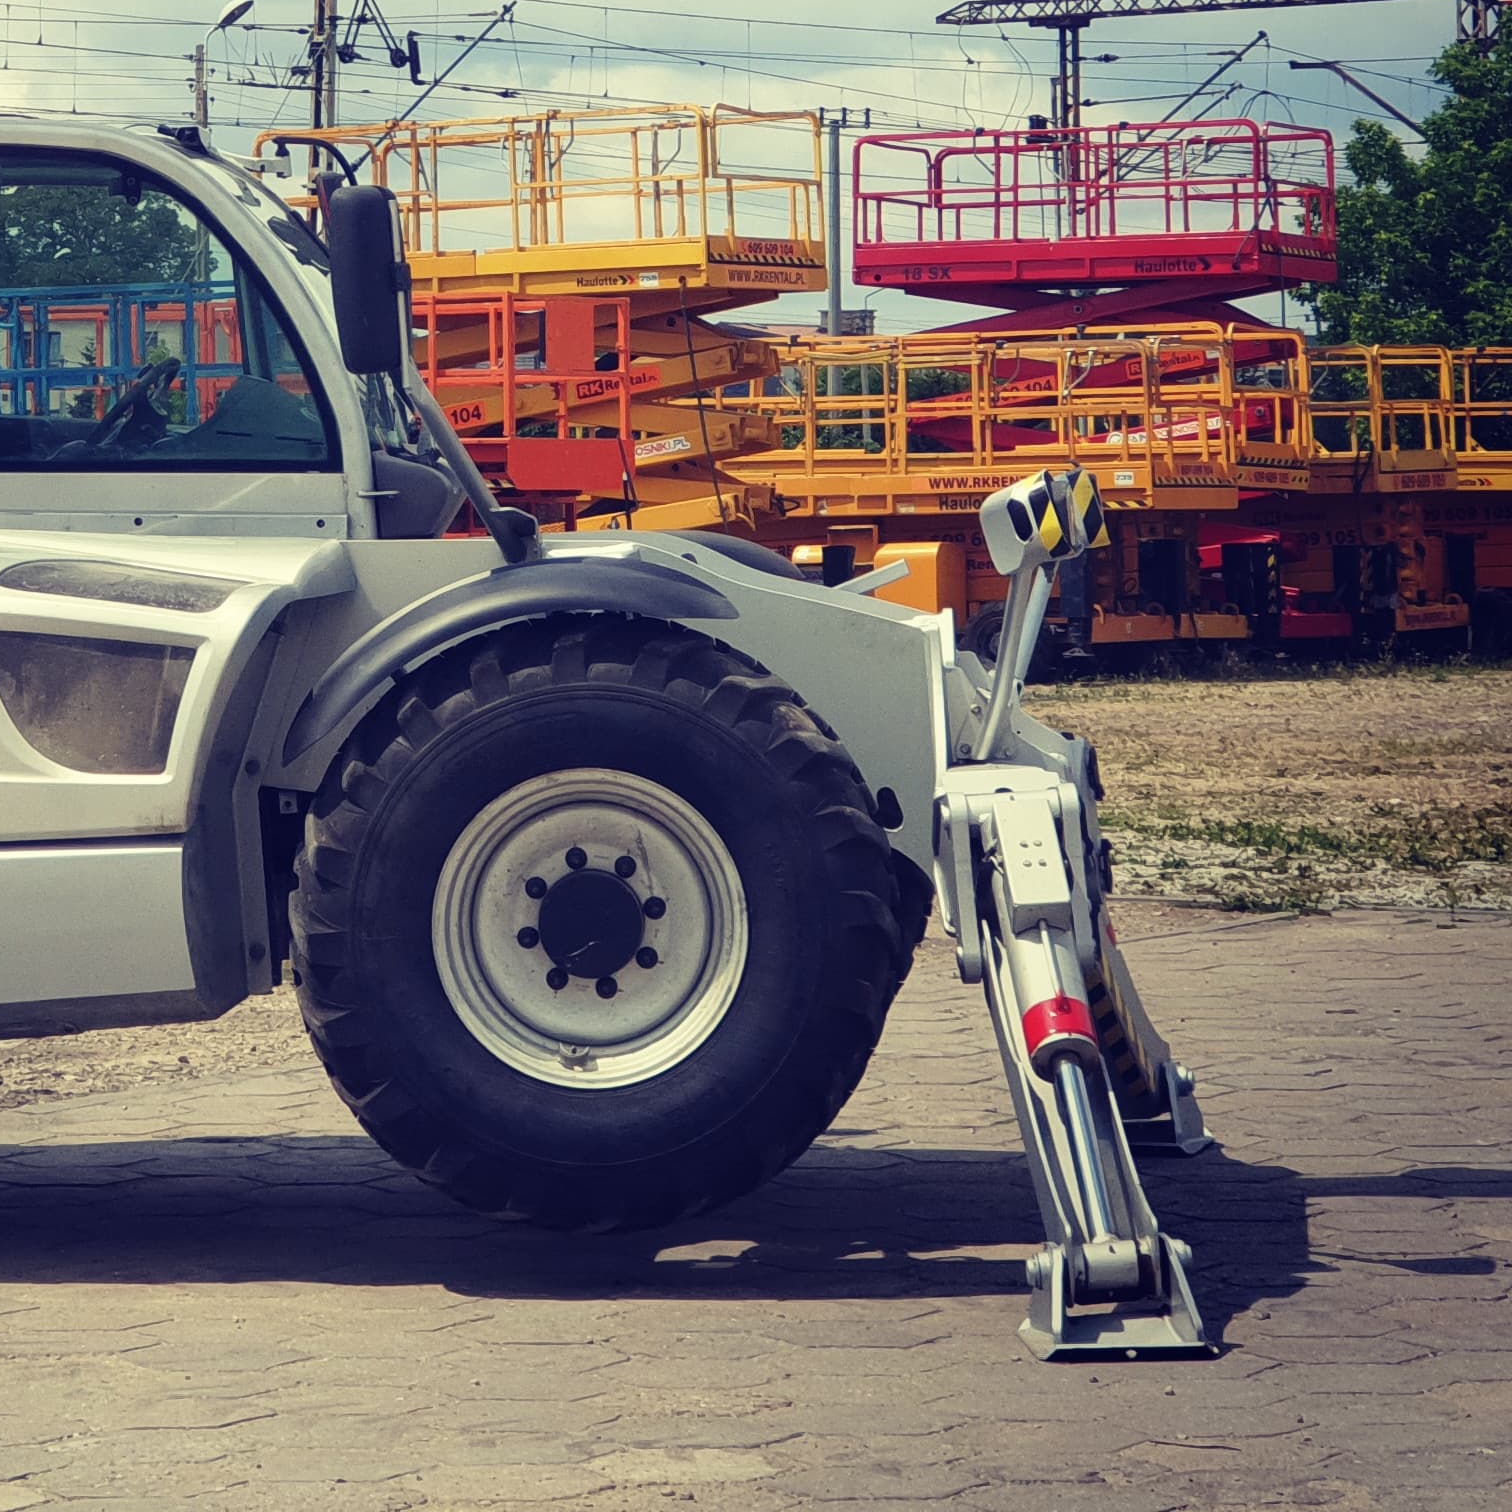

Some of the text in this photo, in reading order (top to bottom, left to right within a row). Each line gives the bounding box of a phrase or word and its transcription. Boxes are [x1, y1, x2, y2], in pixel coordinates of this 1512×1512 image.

[903, 266, 951, 281] 18 SX
[1134, 257, 1197, 274] Haulotte
[577, 275, 618, 288] Haulotte
[577, 379, 604, 399] RK
[450, 405, 482, 425] 104
[635, 439, 689, 457] OSNIKI.PL
[929, 476, 1025, 489] WWW.RKREN
[1326, 530, 1357, 545] 105
